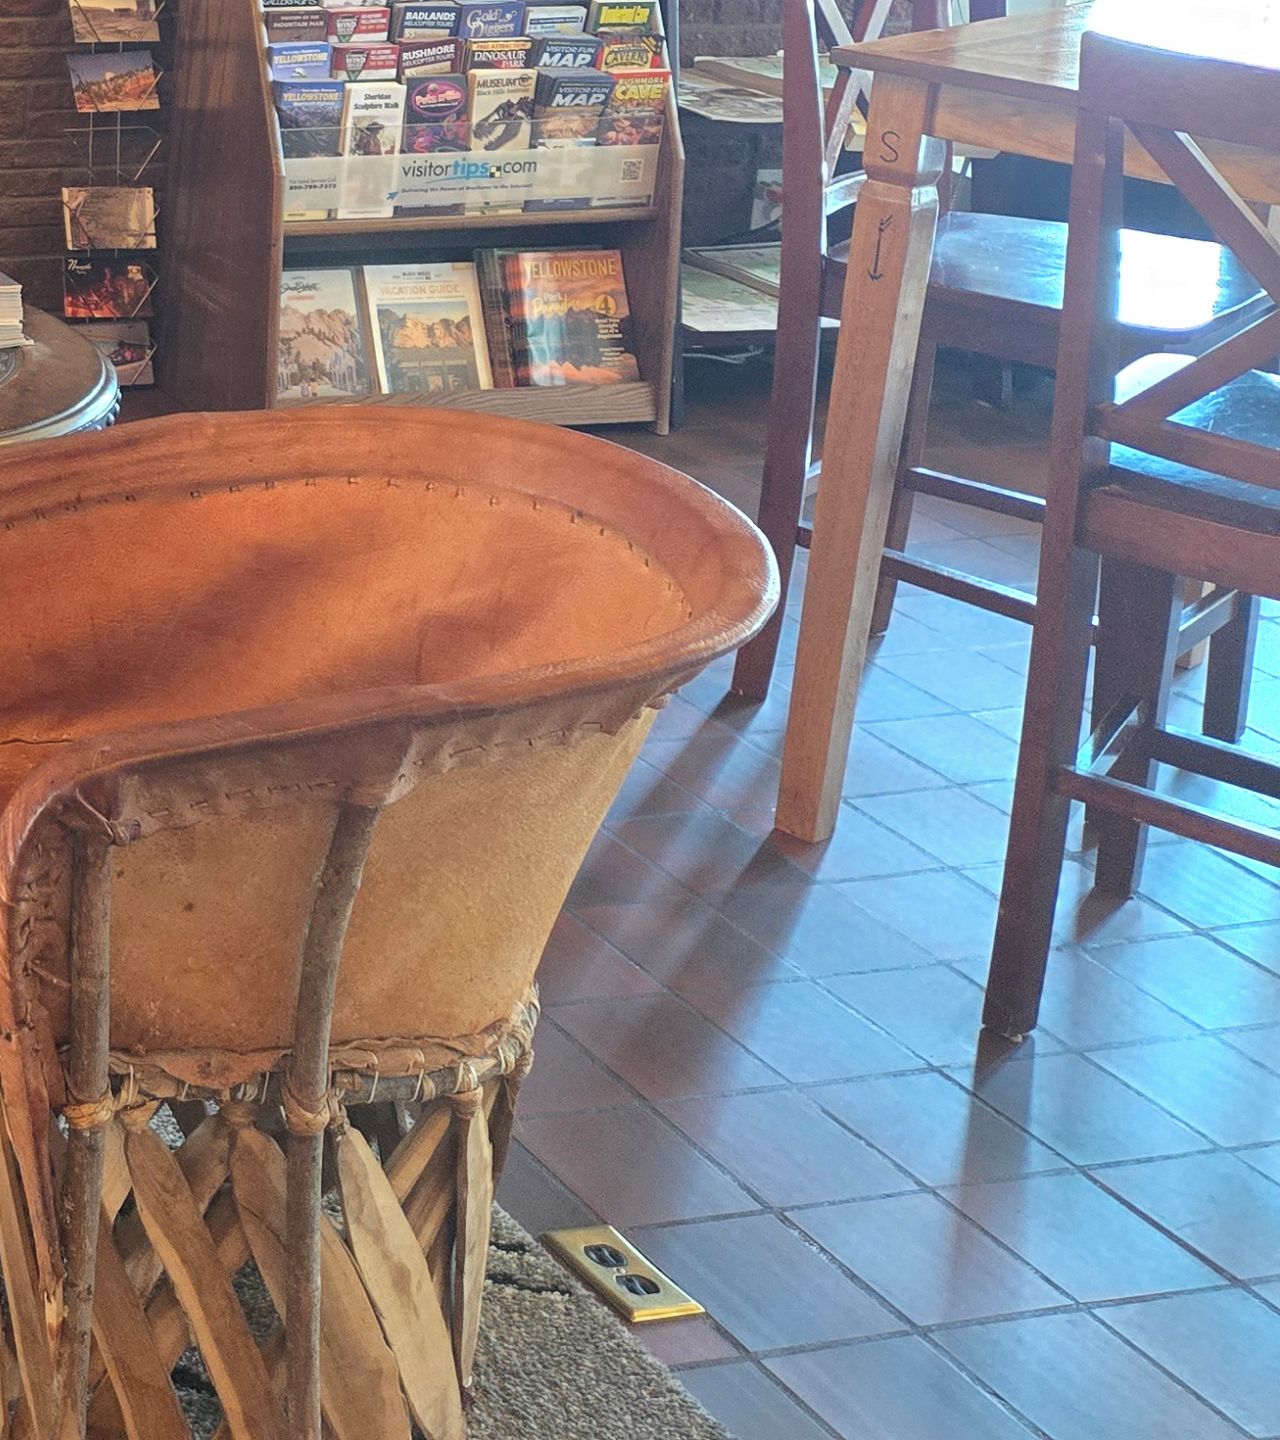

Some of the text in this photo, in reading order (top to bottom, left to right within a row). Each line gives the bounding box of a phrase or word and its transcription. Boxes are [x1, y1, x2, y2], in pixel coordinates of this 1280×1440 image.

[405, 12, 456, 20] BADLANDS
[467, 9, 500, 28] Gold
[469, 22, 515, 37] Diggers
[403, 44, 455, 60] RUSHMORE
[474, 51, 527, 61] DINOSAUR
[273, 53, 328, 64] YELLOWSTONE
[502, 60, 525, 68] PARK
[539, 53, 592, 67] MAP
[605, 51, 650, 66] CAVERNS
[477, 78, 517, 89] MUSEUM
[283, 92, 340, 101] YELLOWSTONE
[364, 93, 391, 101] Sheridan
[615, 84, 662, 100] CAVE
[354, 102, 382, 110] Sculpture
[551, 94, 606, 107] MAP
[524, 259, 617, 278] YELLOWSTONE
[379, 284, 461, 295] VACATION GUIDE
